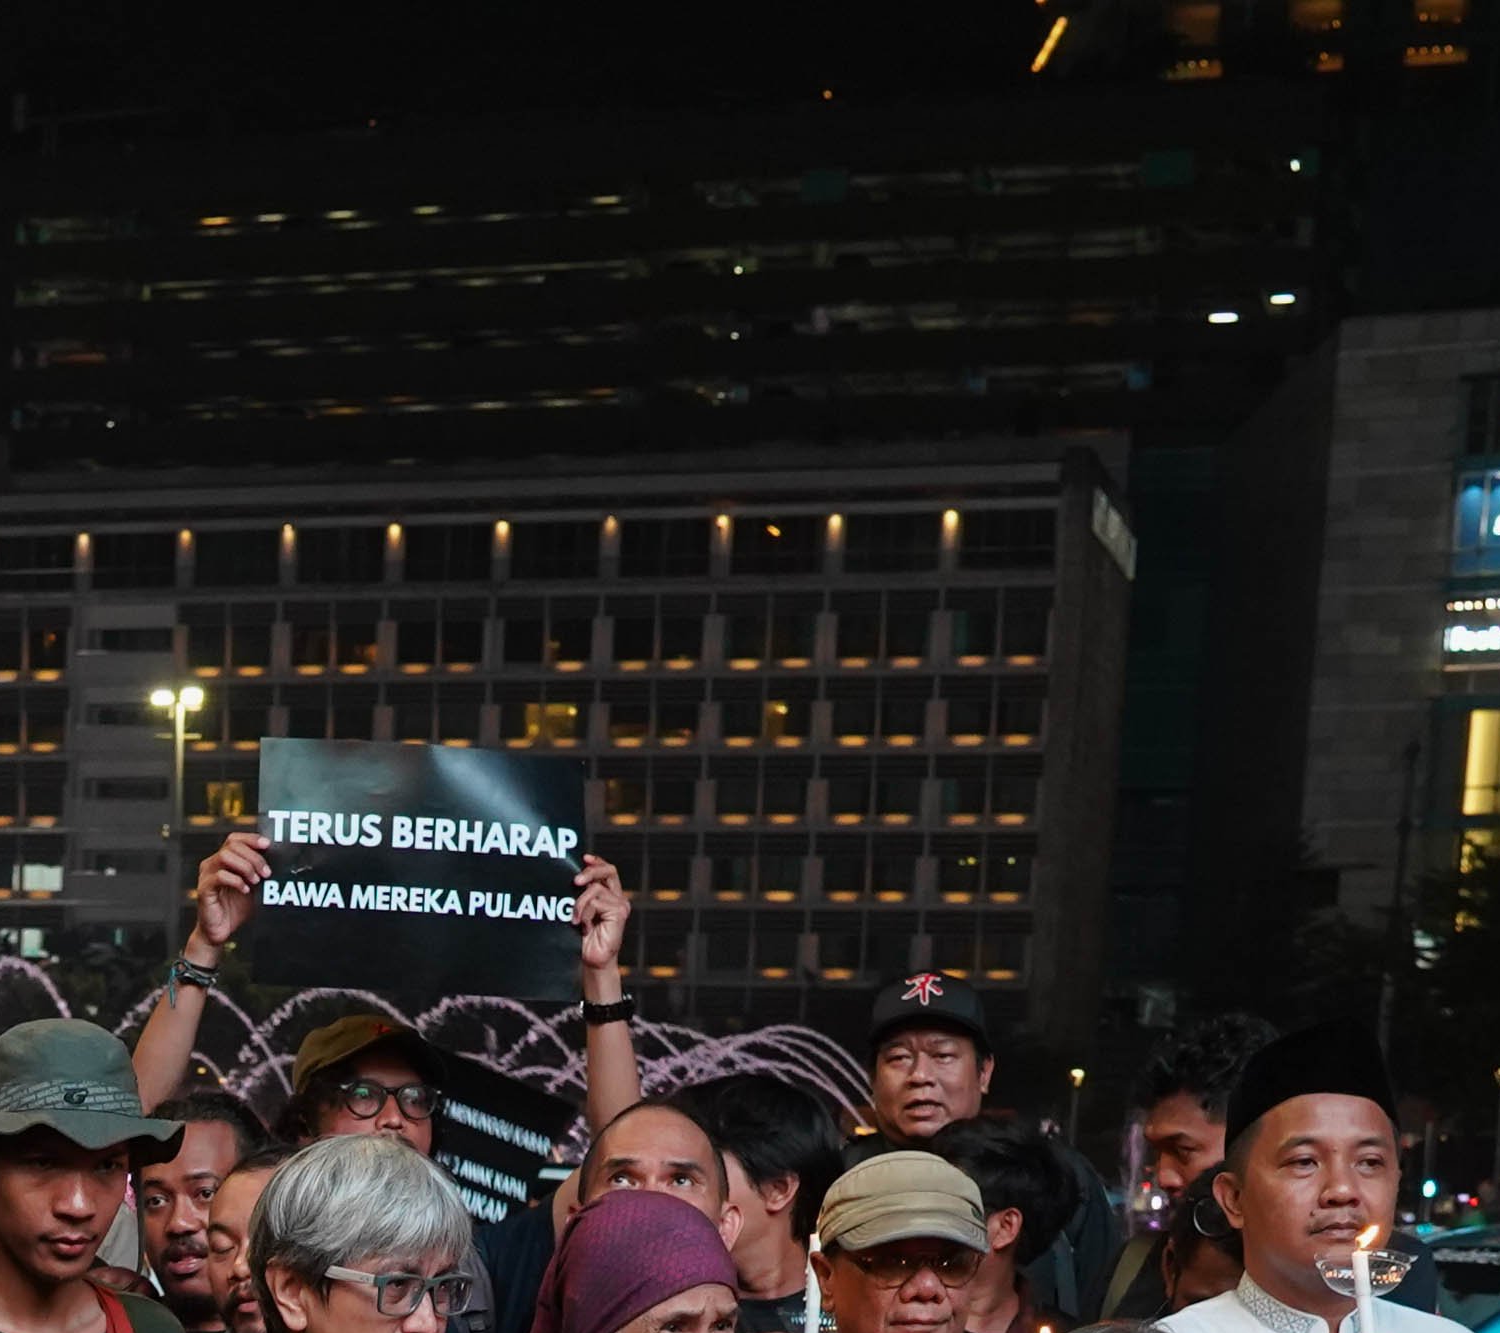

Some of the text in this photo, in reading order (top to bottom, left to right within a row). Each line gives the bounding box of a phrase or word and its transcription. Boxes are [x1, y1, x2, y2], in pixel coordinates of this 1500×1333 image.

[268, 810, 578, 859] TERUS BERHARAP
[262, 880, 576, 922] BAWA MEREKA PULANG
[493, 1170, 527, 1203] KAPAL
